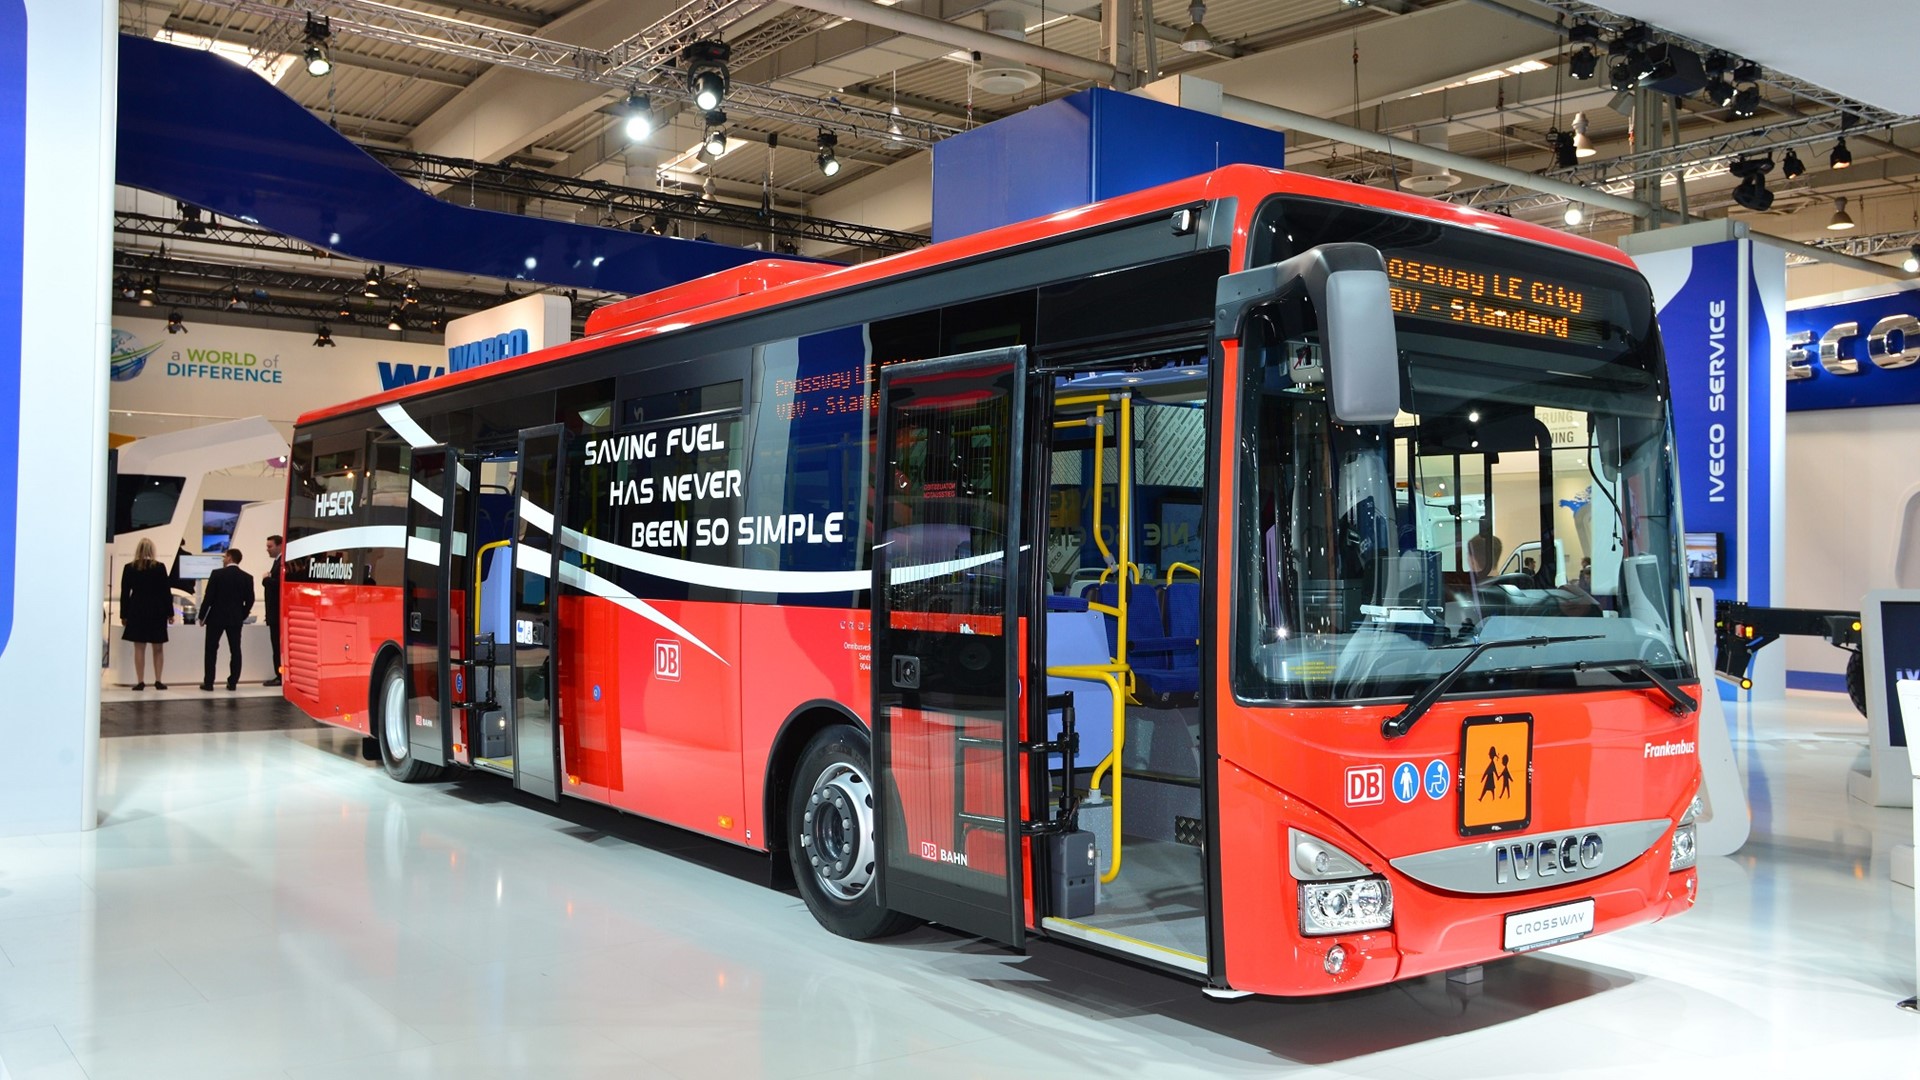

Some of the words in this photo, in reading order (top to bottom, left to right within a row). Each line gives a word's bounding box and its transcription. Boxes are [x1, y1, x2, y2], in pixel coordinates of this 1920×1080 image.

[1494, 274, 1522, 300] LE
[1531, 281, 1582, 314] City
[1451, 298, 1568, 338] Standard
[171, 351, 180, 361] a
[187, 348, 257, 366] WORLD
[263, 355, 279, 368] of
[448, 328, 528, 373] WABCO
[1709, 300, 1725, 411] SERVICE
[167, 363, 282, 383] DIFFERENCE
[775, 370, 850, 397] Crossway
[855, 364, 876, 384] LE
[776, 401, 806, 421] VDV
[584, 432, 657, 466] SAVING
[666, 423, 724, 456] FUEL
[1709, 424, 1725, 502] IVECO
[609, 478, 654, 506] HAS
[662, 469, 741, 502] NEVER
[631, 519, 688, 548] BEEN
[695, 517, 729, 547] SO
[738, 512, 844, 545] SIMPLE
[308, 557, 354, 579] Frankenbus
[657, 645, 679, 675] DB
[1644, 740, 1695, 759] Frankenbus
[1350, 770, 1380, 799] DB
[922, 843, 936, 859] DB
[940, 848, 968, 867] BAHN
[1496, 832, 1604, 885] IVECO
[1515, 911, 1585, 936] CROSSWAY
